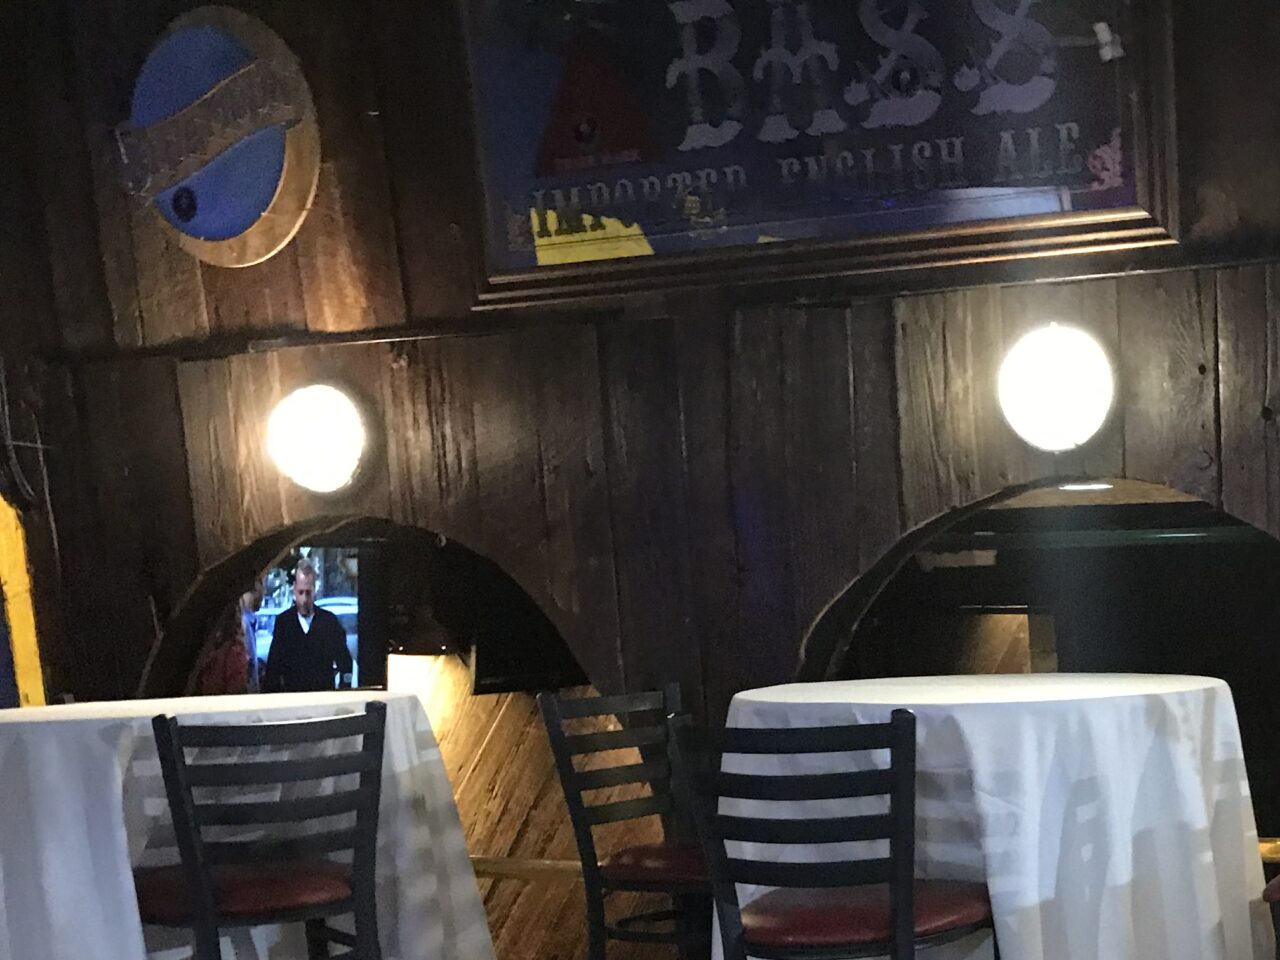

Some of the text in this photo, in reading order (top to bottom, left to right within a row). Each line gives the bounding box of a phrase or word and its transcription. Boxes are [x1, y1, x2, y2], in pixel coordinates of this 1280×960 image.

[665, 0, 1059, 152] BASS
[533, 121, 1084, 238] IMPORTED ENGLISH ALE
